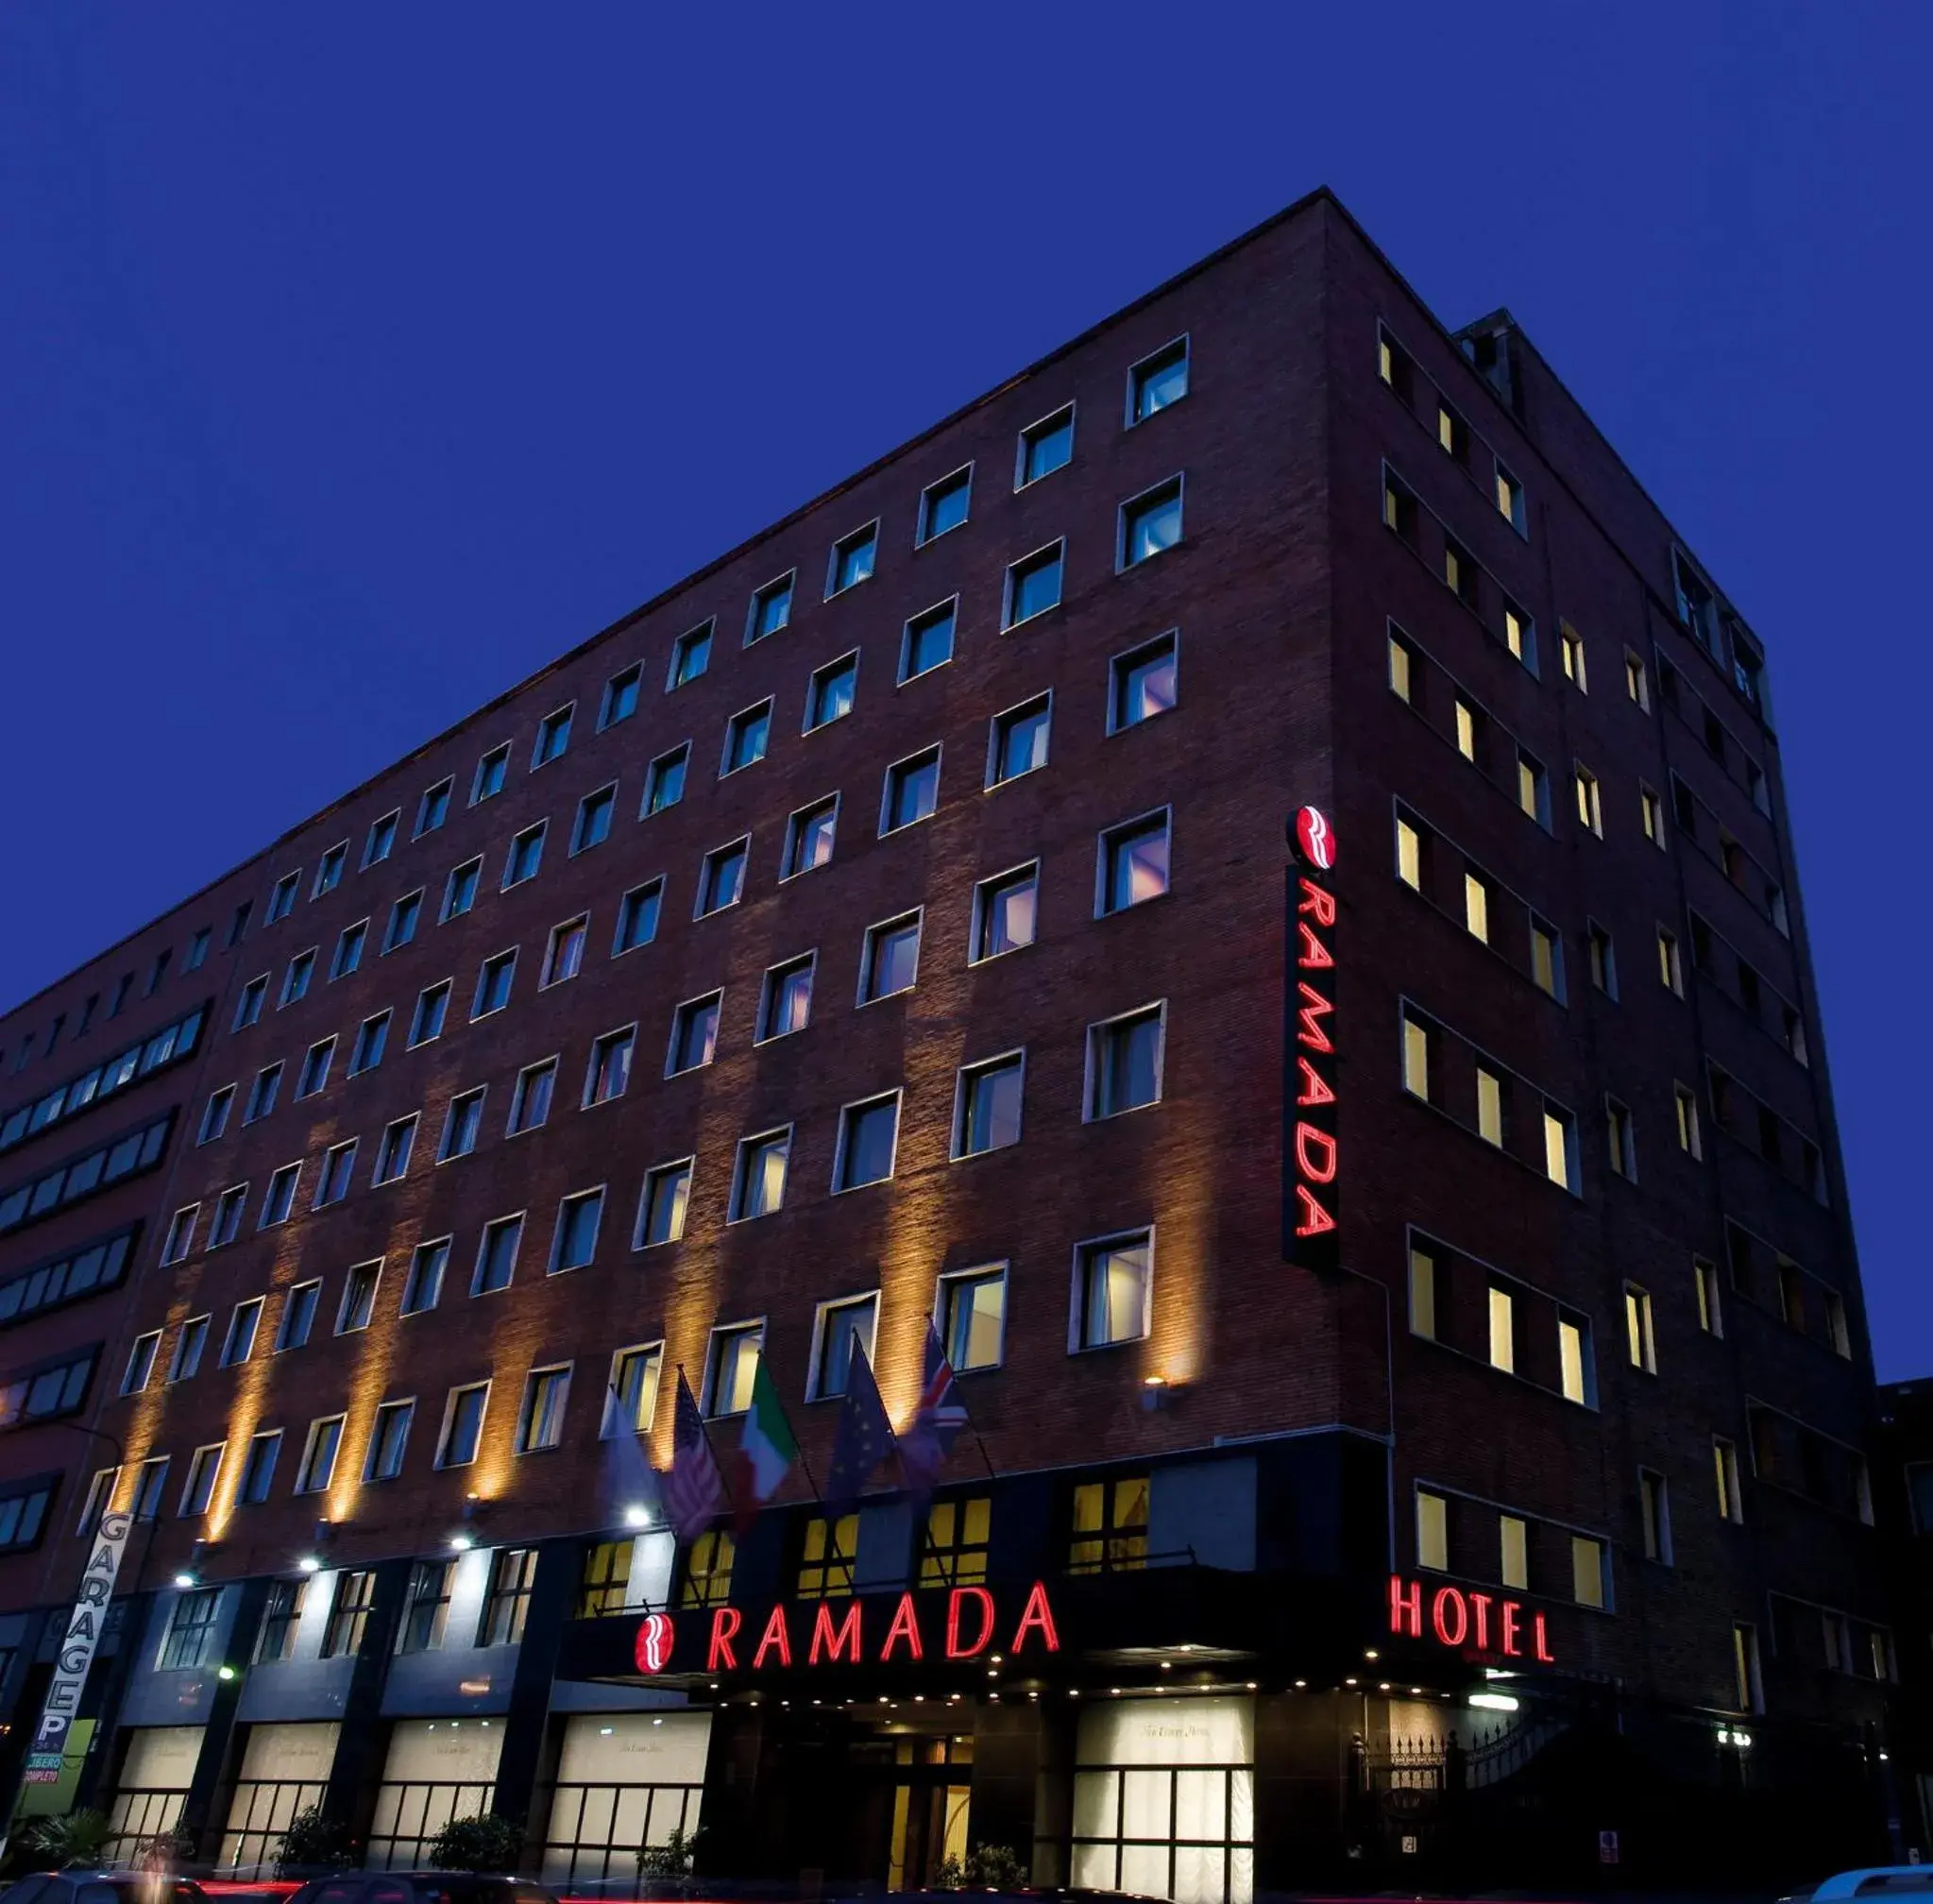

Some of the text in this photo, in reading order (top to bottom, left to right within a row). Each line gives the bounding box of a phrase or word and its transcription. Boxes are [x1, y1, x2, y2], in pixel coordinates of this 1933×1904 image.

[1296, 877, 1337, 1237] RAMADA
[48, 1514, 130, 1711] GARAGE
[706, 1579, 1060, 1673] RAMADA
[1390, 1574, 1555, 1662] HOTEL
[38, 1715, 66, 1742] P
